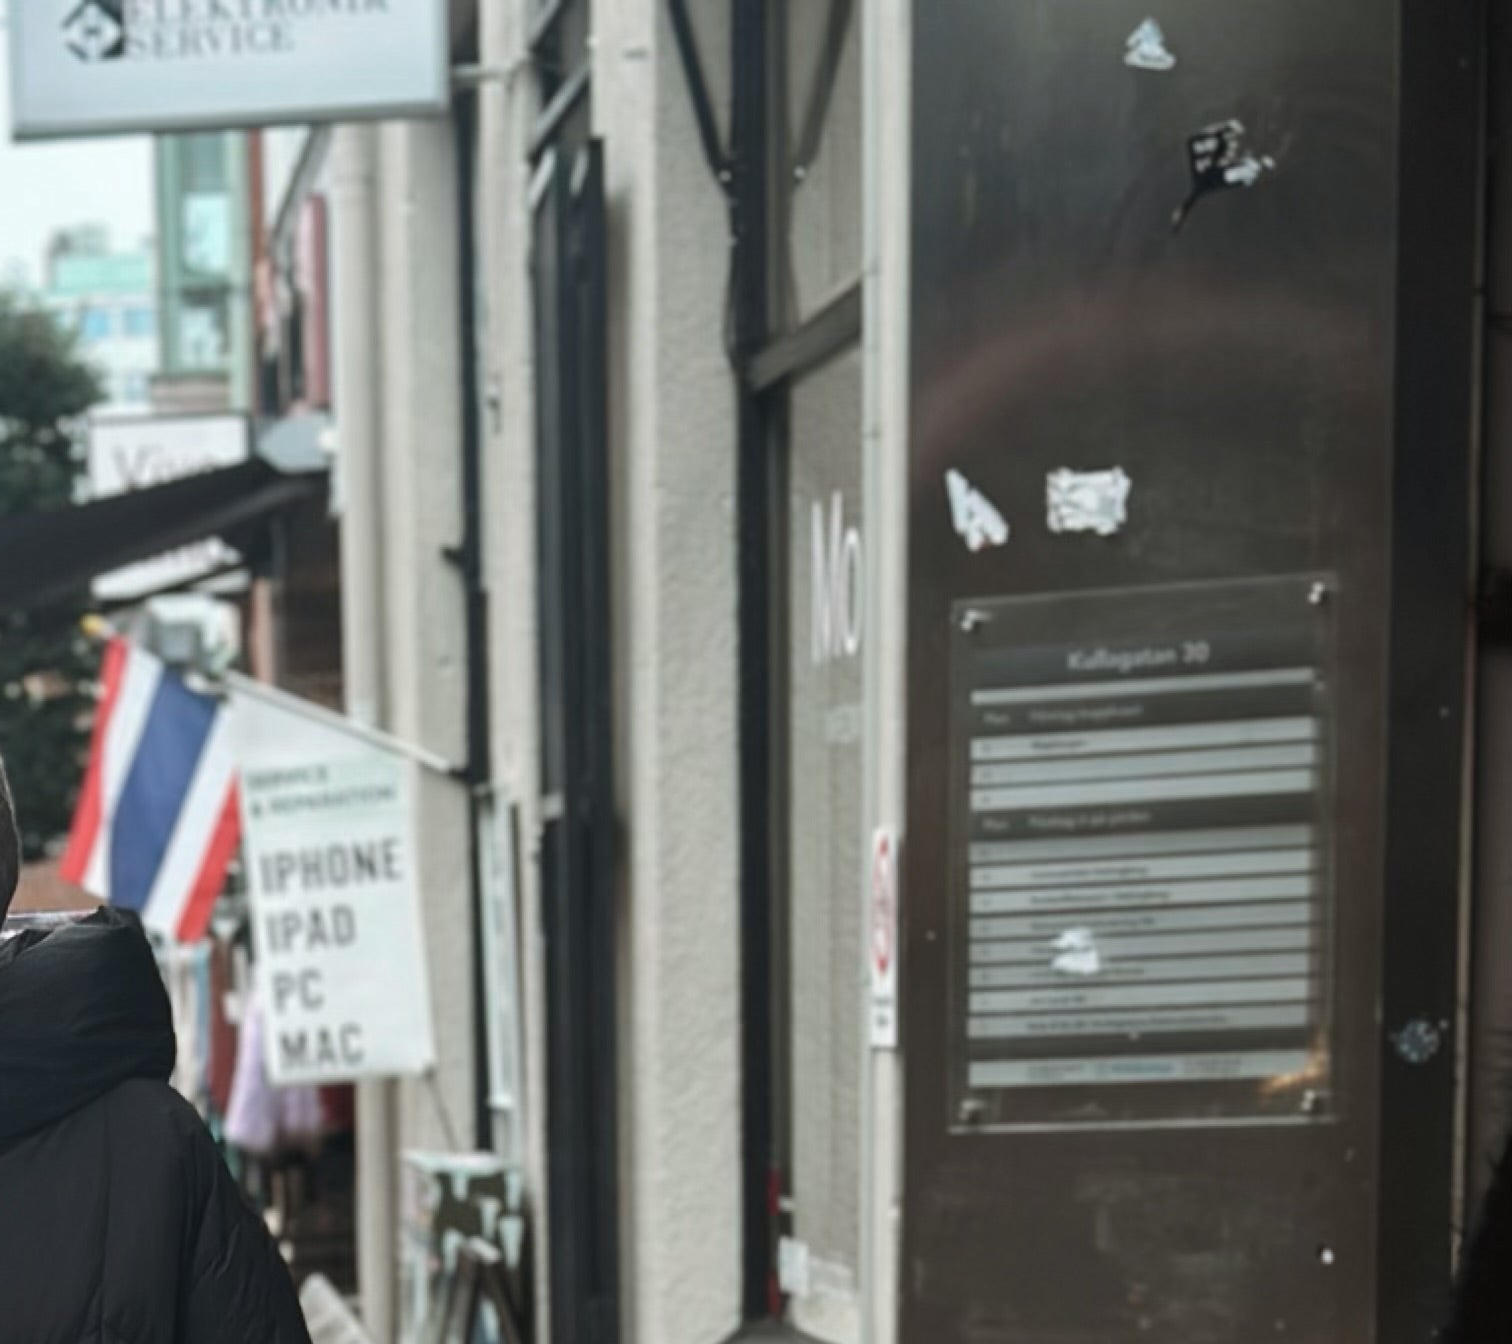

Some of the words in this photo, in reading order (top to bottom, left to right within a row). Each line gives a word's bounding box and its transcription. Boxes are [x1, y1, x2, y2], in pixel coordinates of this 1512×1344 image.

[126, 21, 297, 60] SERVICE
[259, 837, 402, 895] IPHONE
[266, 904, 357, 953] IPAD
[273, 969, 325, 1014] PC
[279, 1022, 364, 1070] MAC
